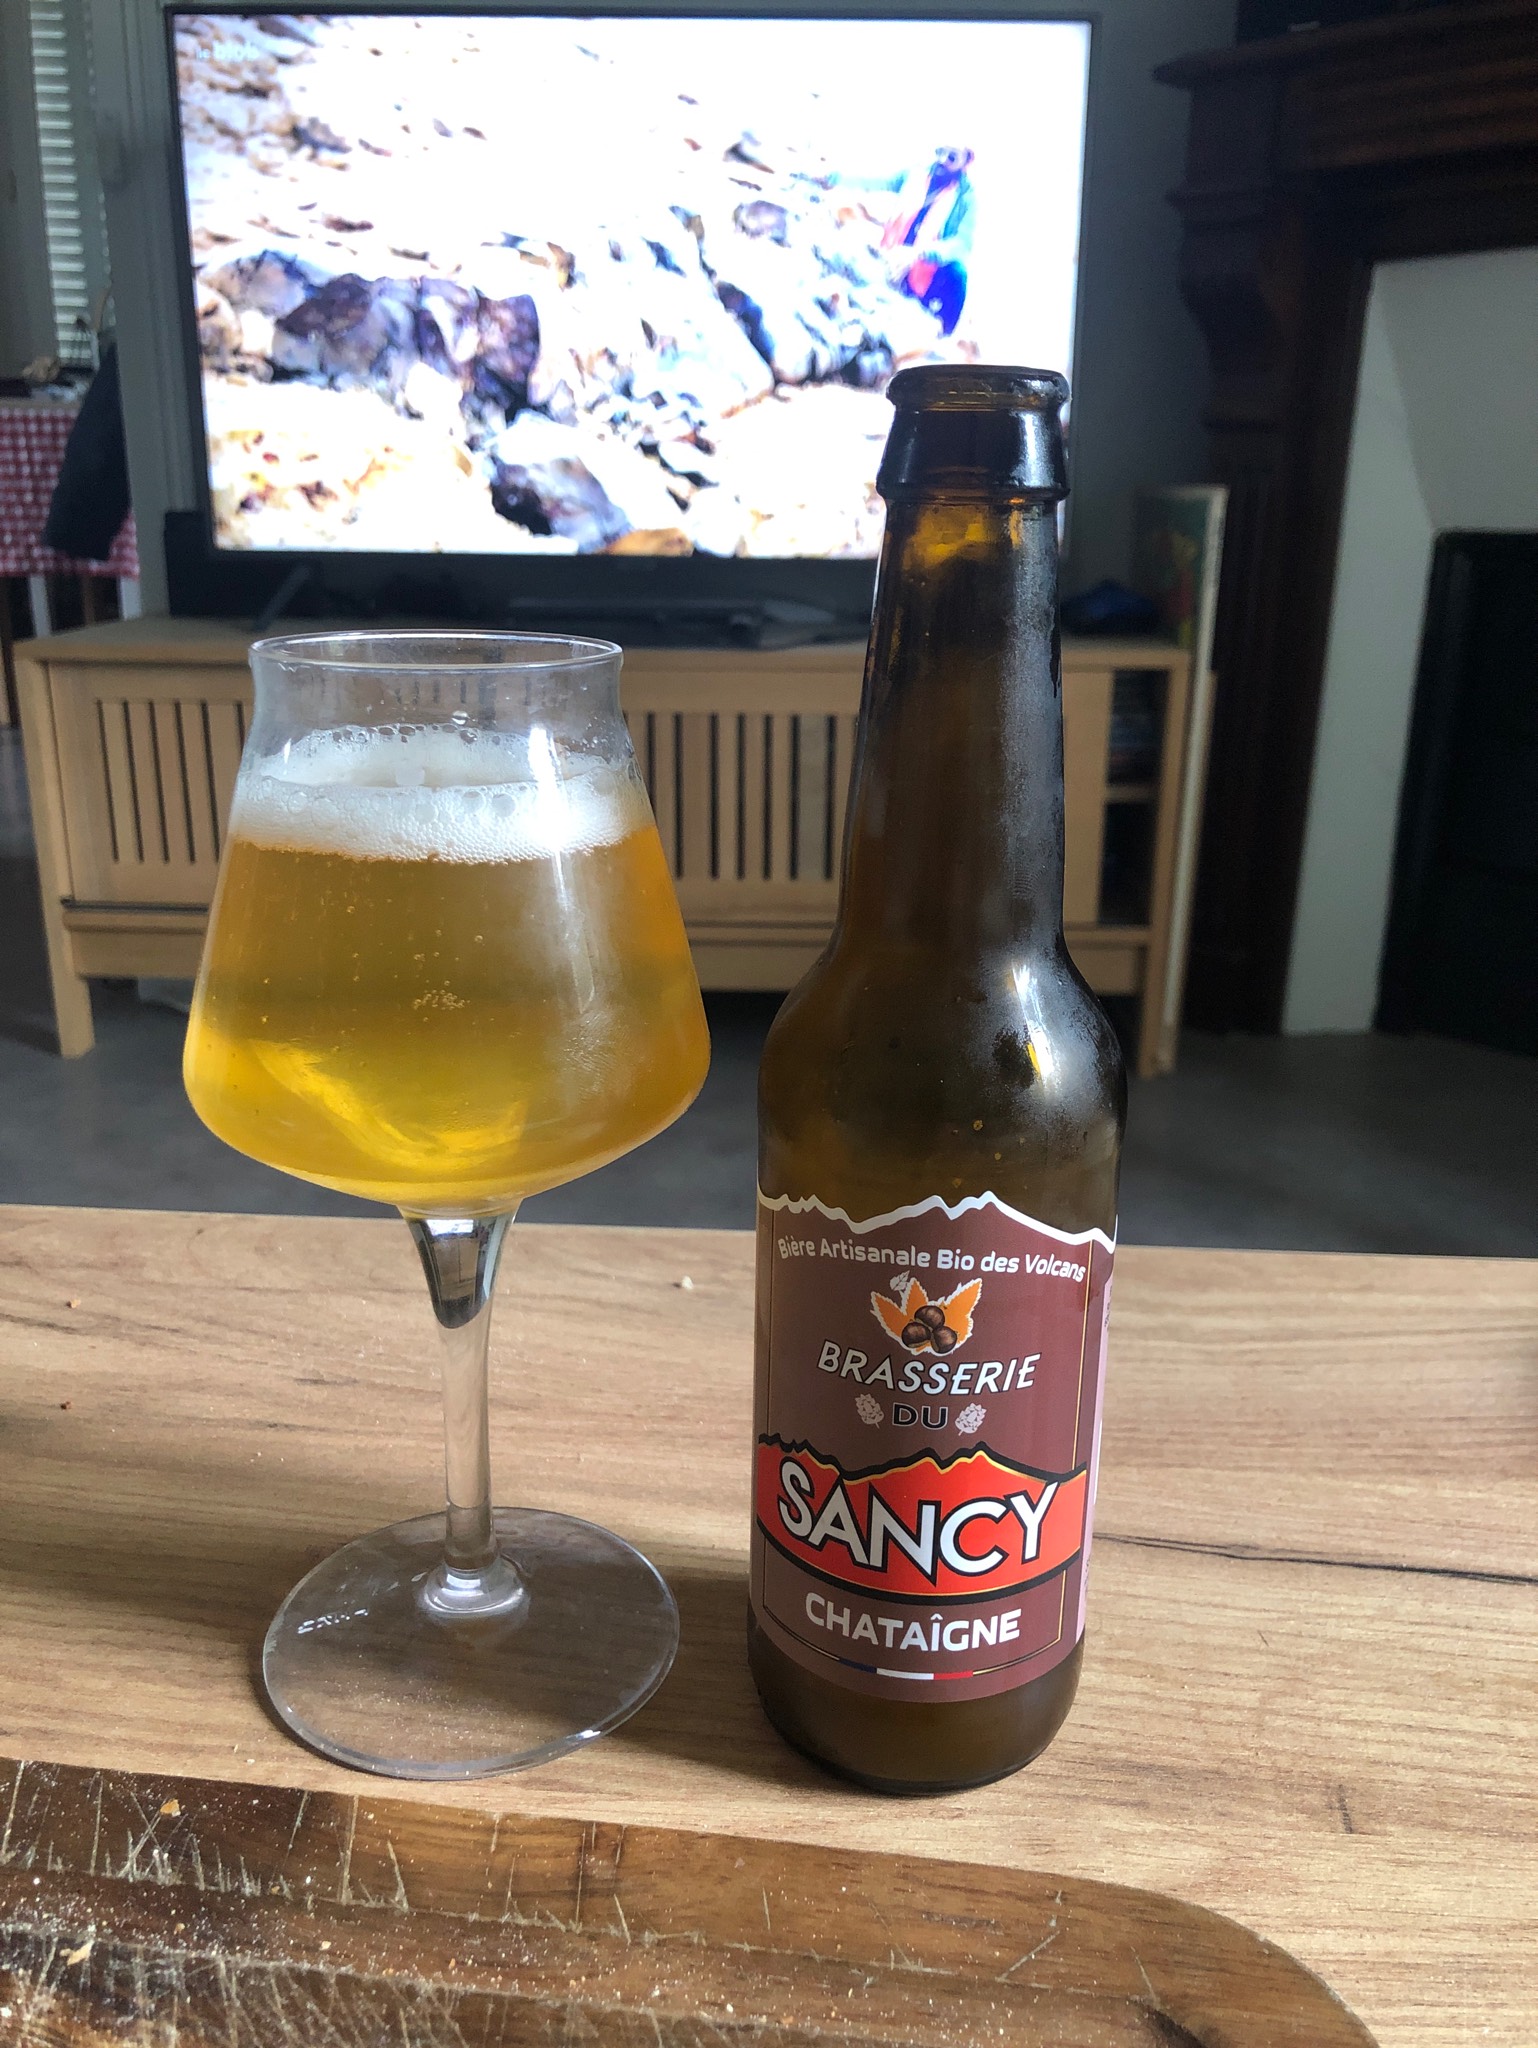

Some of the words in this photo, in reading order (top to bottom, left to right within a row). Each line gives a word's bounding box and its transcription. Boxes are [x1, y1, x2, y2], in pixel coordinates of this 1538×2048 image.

[777, 1235, 816, 1259] Bière
[820, 1238, 931, 1268] Artisanale
[936, 1249, 975, 1272] Bio
[980, 1251, 1020, 1274] des
[1025, 1253, 1087, 1282] Volcans
[816, 1340, 1042, 1396] BRASSERIE
[892, 1402, 949, 1430] DU
[777, 1456, 1063, 1587] SANCY
[804, 1592, 1022, 1652] CHATAÎGNE
